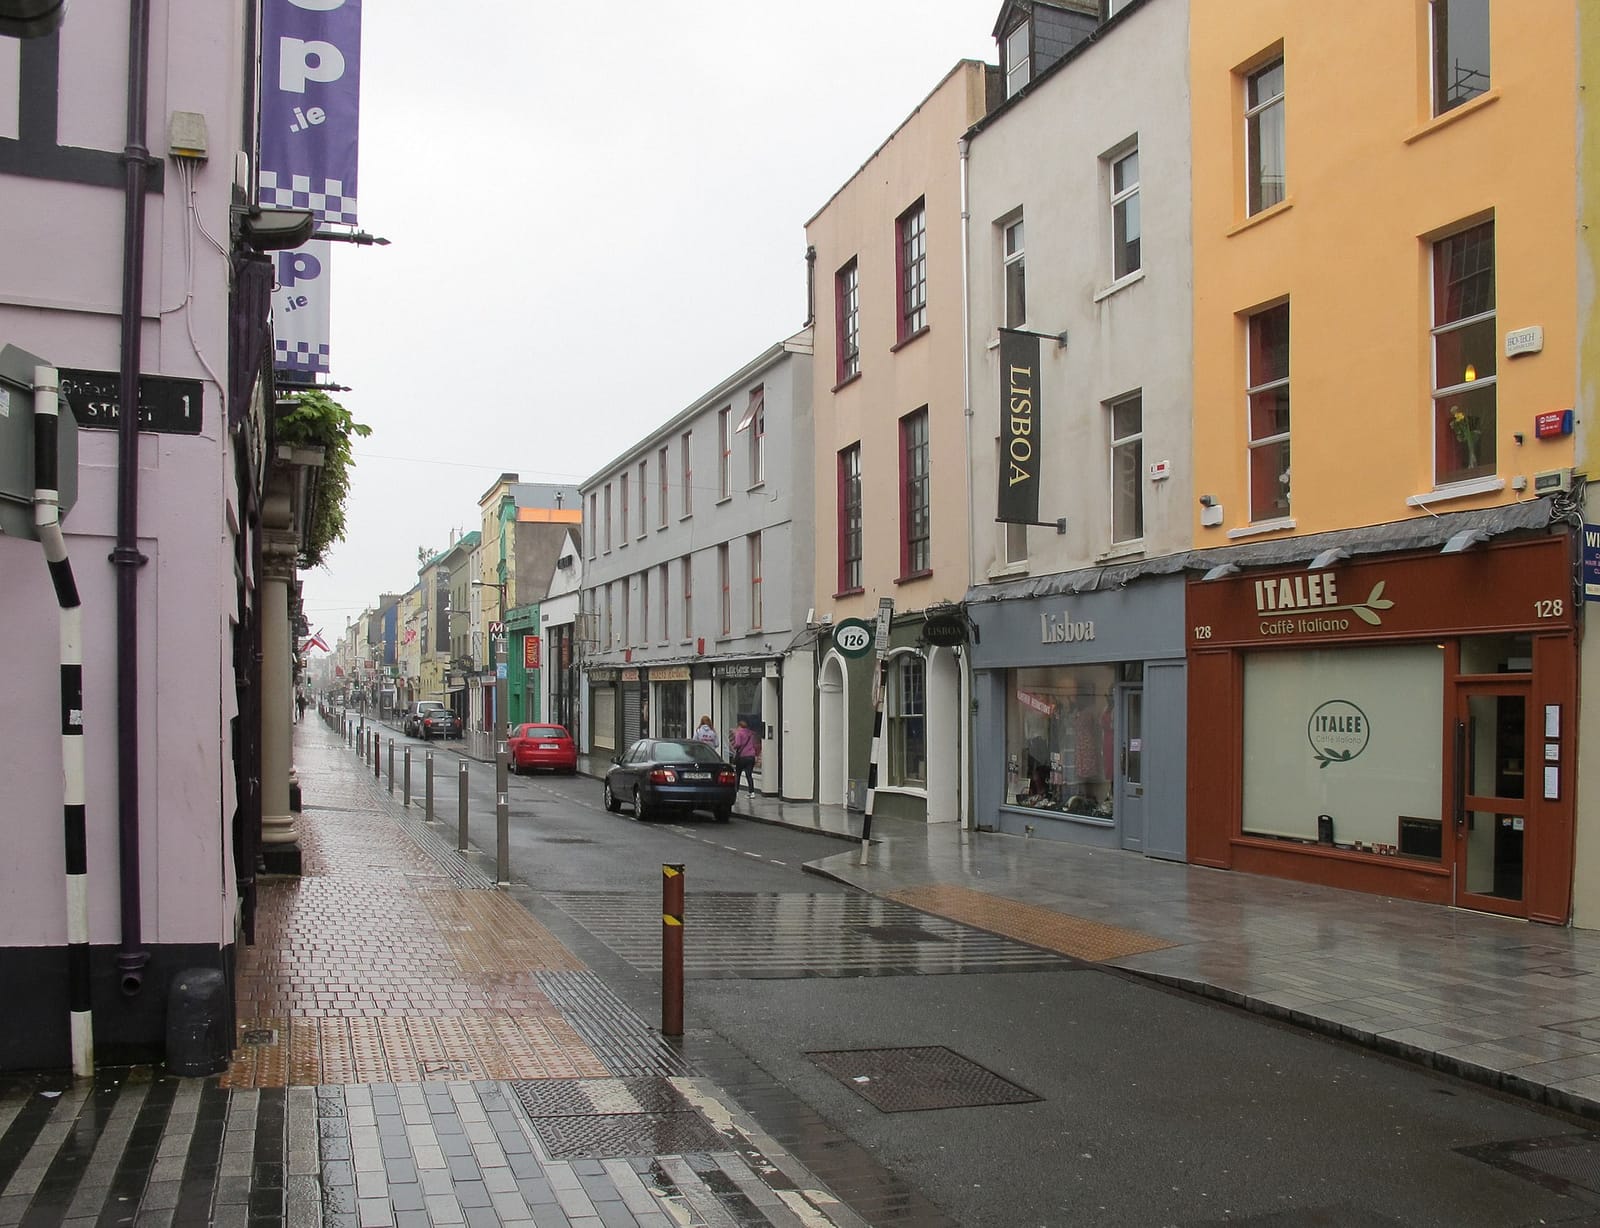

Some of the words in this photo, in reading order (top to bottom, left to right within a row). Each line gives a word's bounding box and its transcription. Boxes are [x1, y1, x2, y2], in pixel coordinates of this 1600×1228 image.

[1009, 364, 1032, 487] LISBOA
[1255, 573, 1338, 610] ITALEE
[1534, 599, 1564, 618] 128
[1040, 610, 1096, 643] Lisboa
[1194, 625, 1212, 640] 128
[1260, 619, 1295, 635] Caffè
[1298, 618, 1349, 632] Italiano
[844, 634, 864, 647] 126
[1316, 715, 1361, 733] ITALEE
